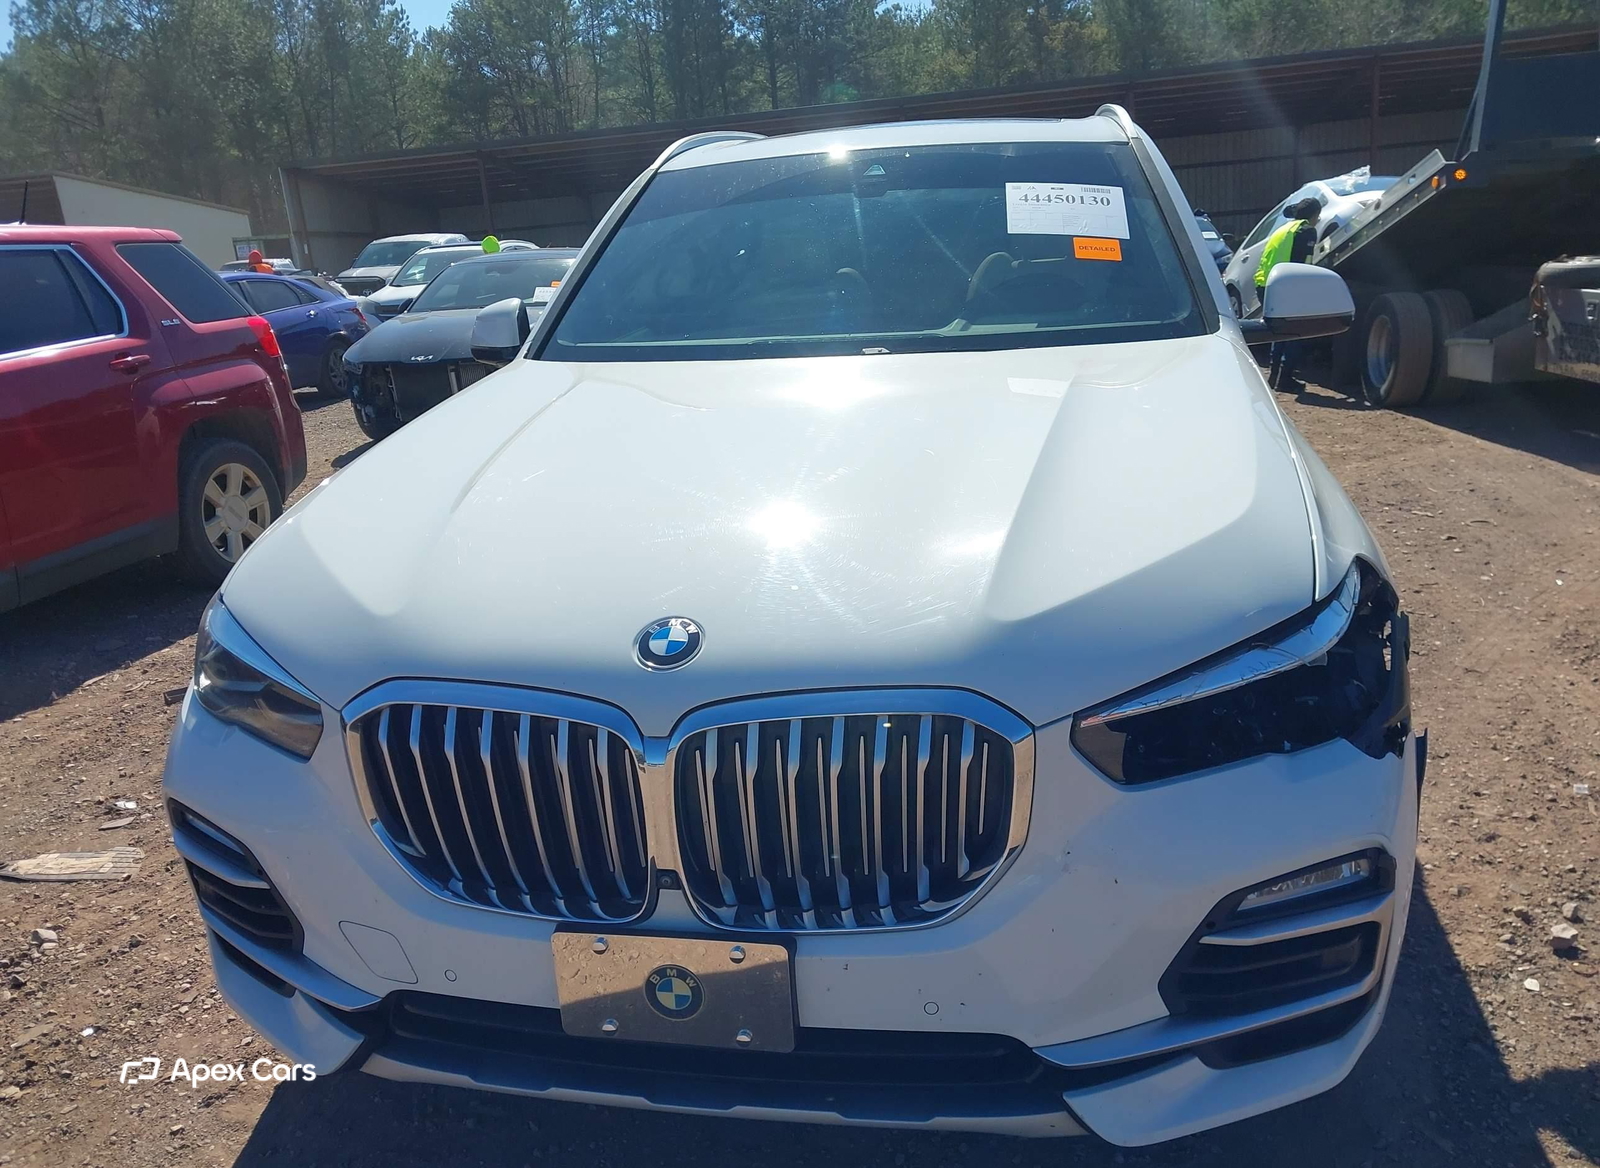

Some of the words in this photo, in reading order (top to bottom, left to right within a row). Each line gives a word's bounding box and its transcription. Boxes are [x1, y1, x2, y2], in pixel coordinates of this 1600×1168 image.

[1019, 193, 1111, 207] 44450130
[1078, 245, 1116, 253] DETAILED
[648, 619, 699, 634] BMW
[649, 968, 698, 988] BMW
